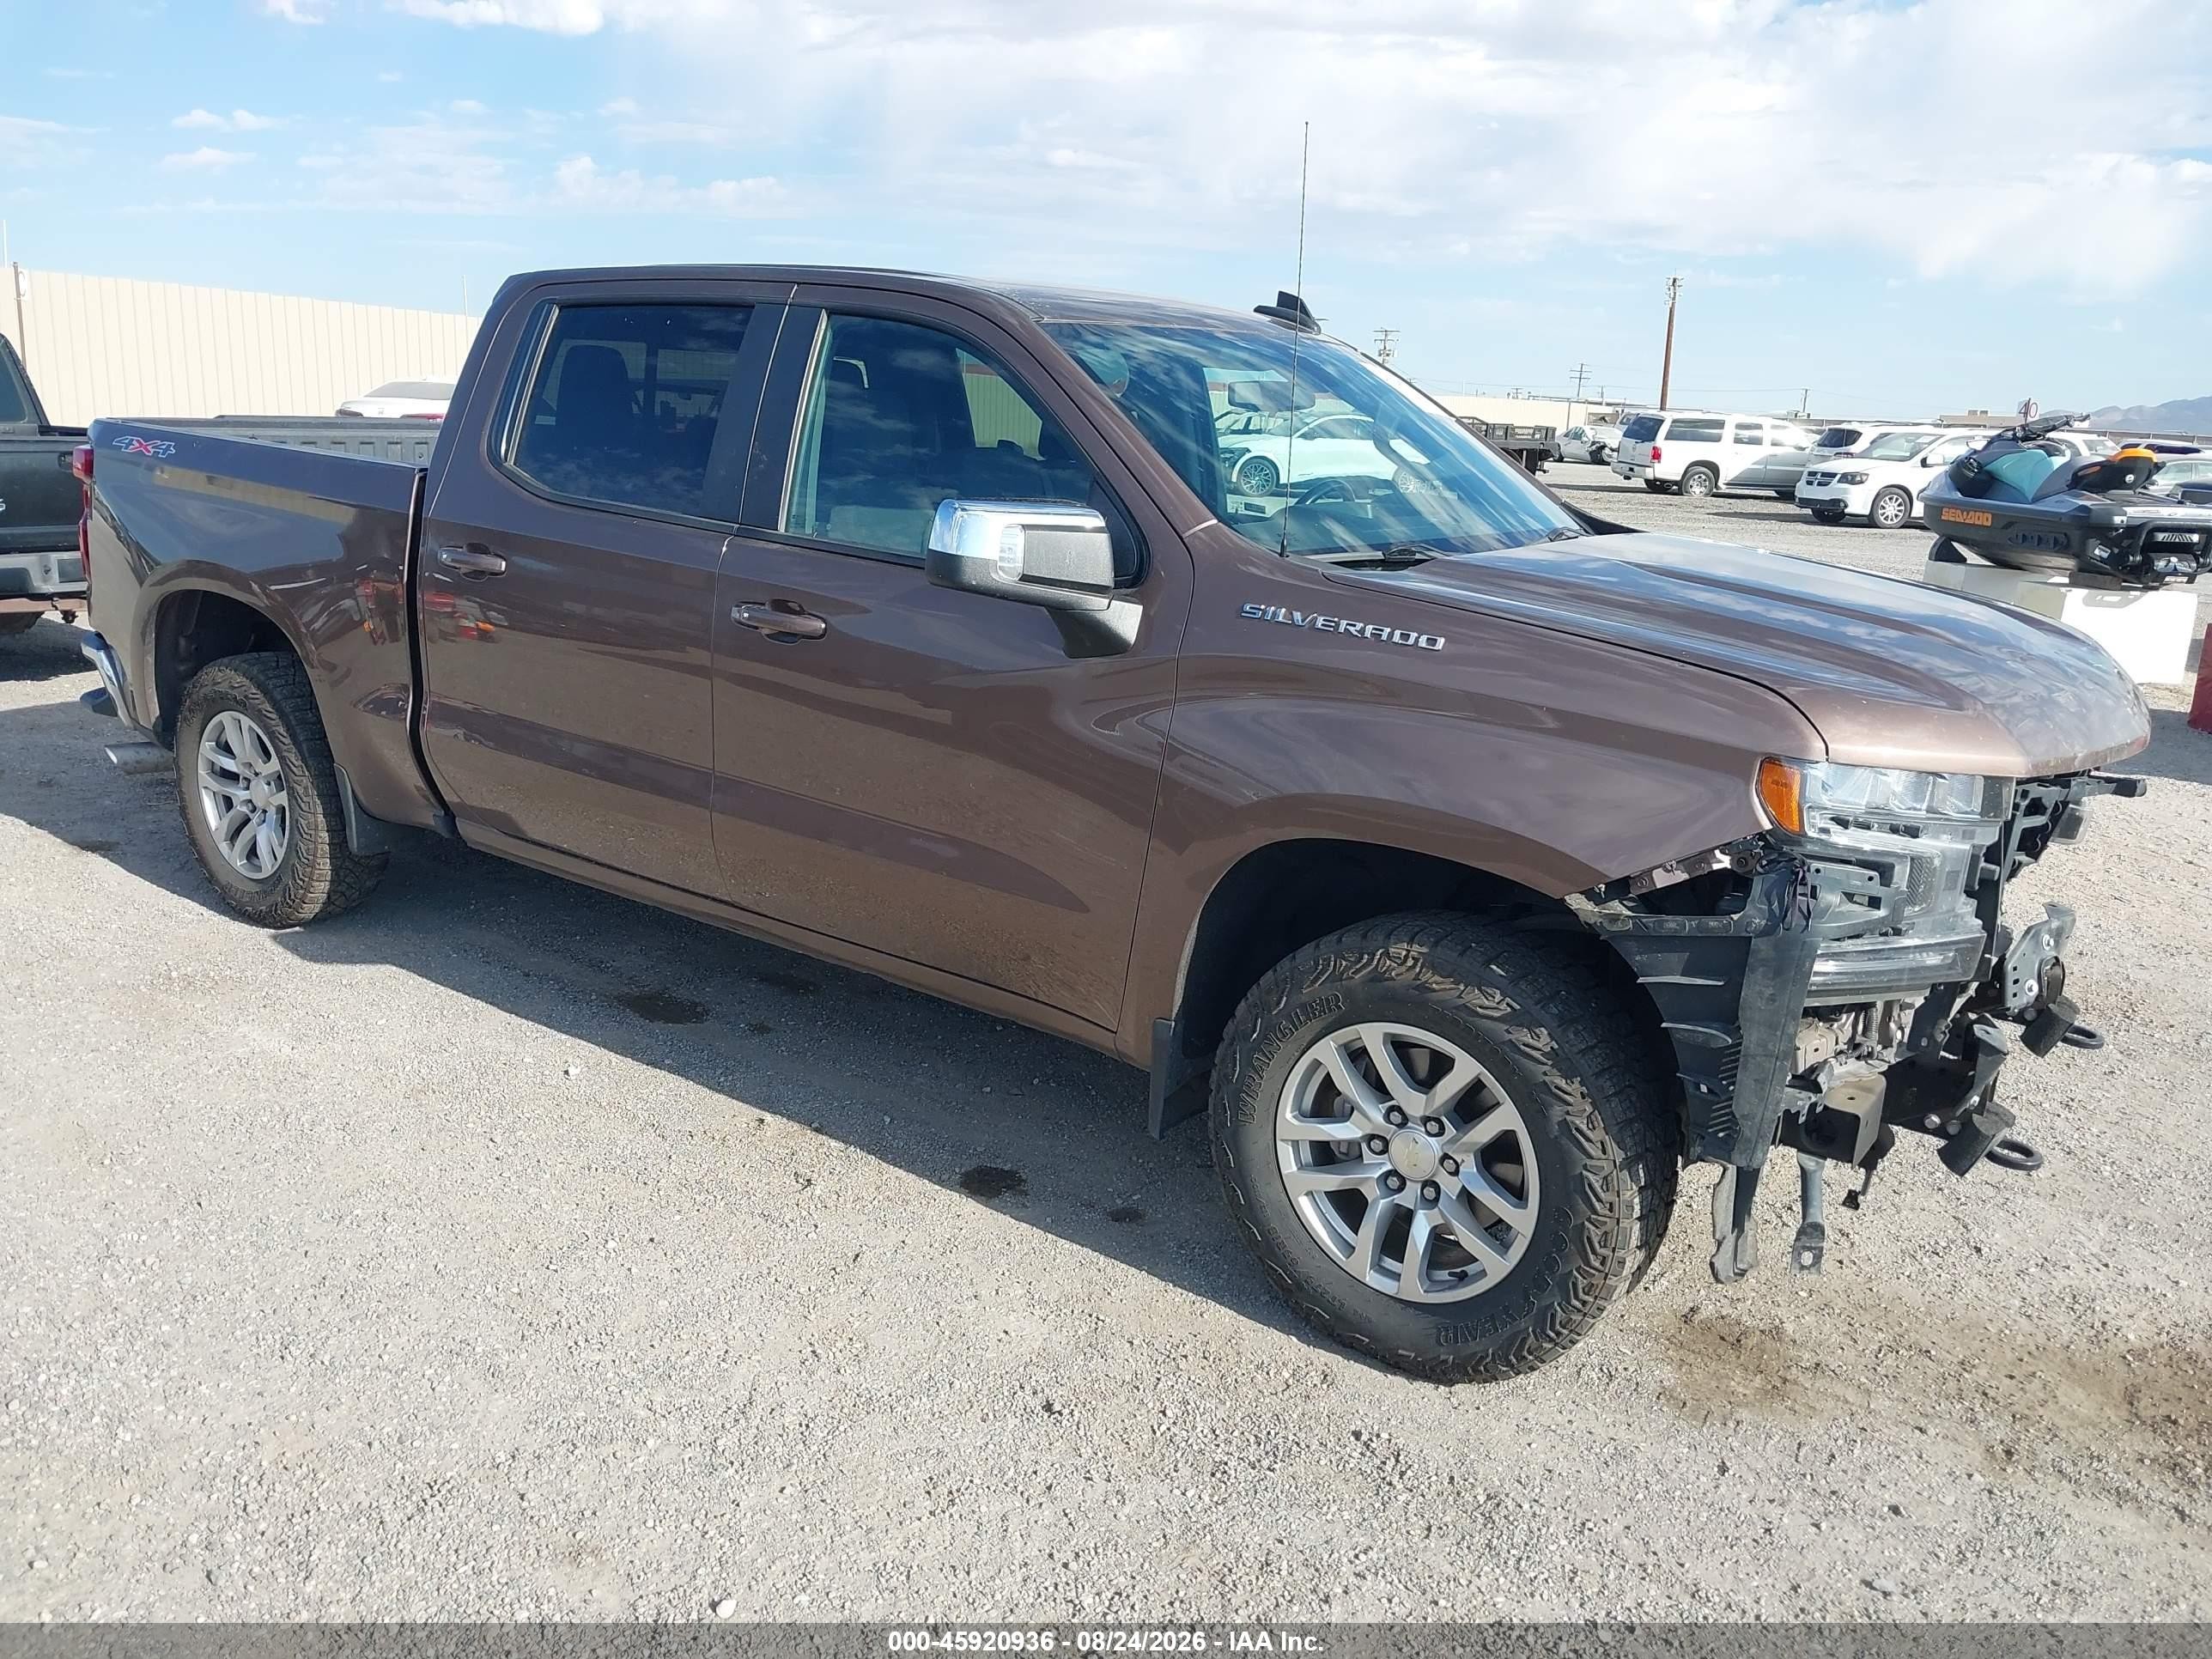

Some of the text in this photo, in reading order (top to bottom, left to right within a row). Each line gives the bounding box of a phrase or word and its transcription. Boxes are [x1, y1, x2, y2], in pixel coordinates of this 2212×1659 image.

[2019, 402, 2039, 418] 40
[1242, 603, 1445, 651] SILVERADO
[1238, 991, 1346, 1125] WRANGLER
